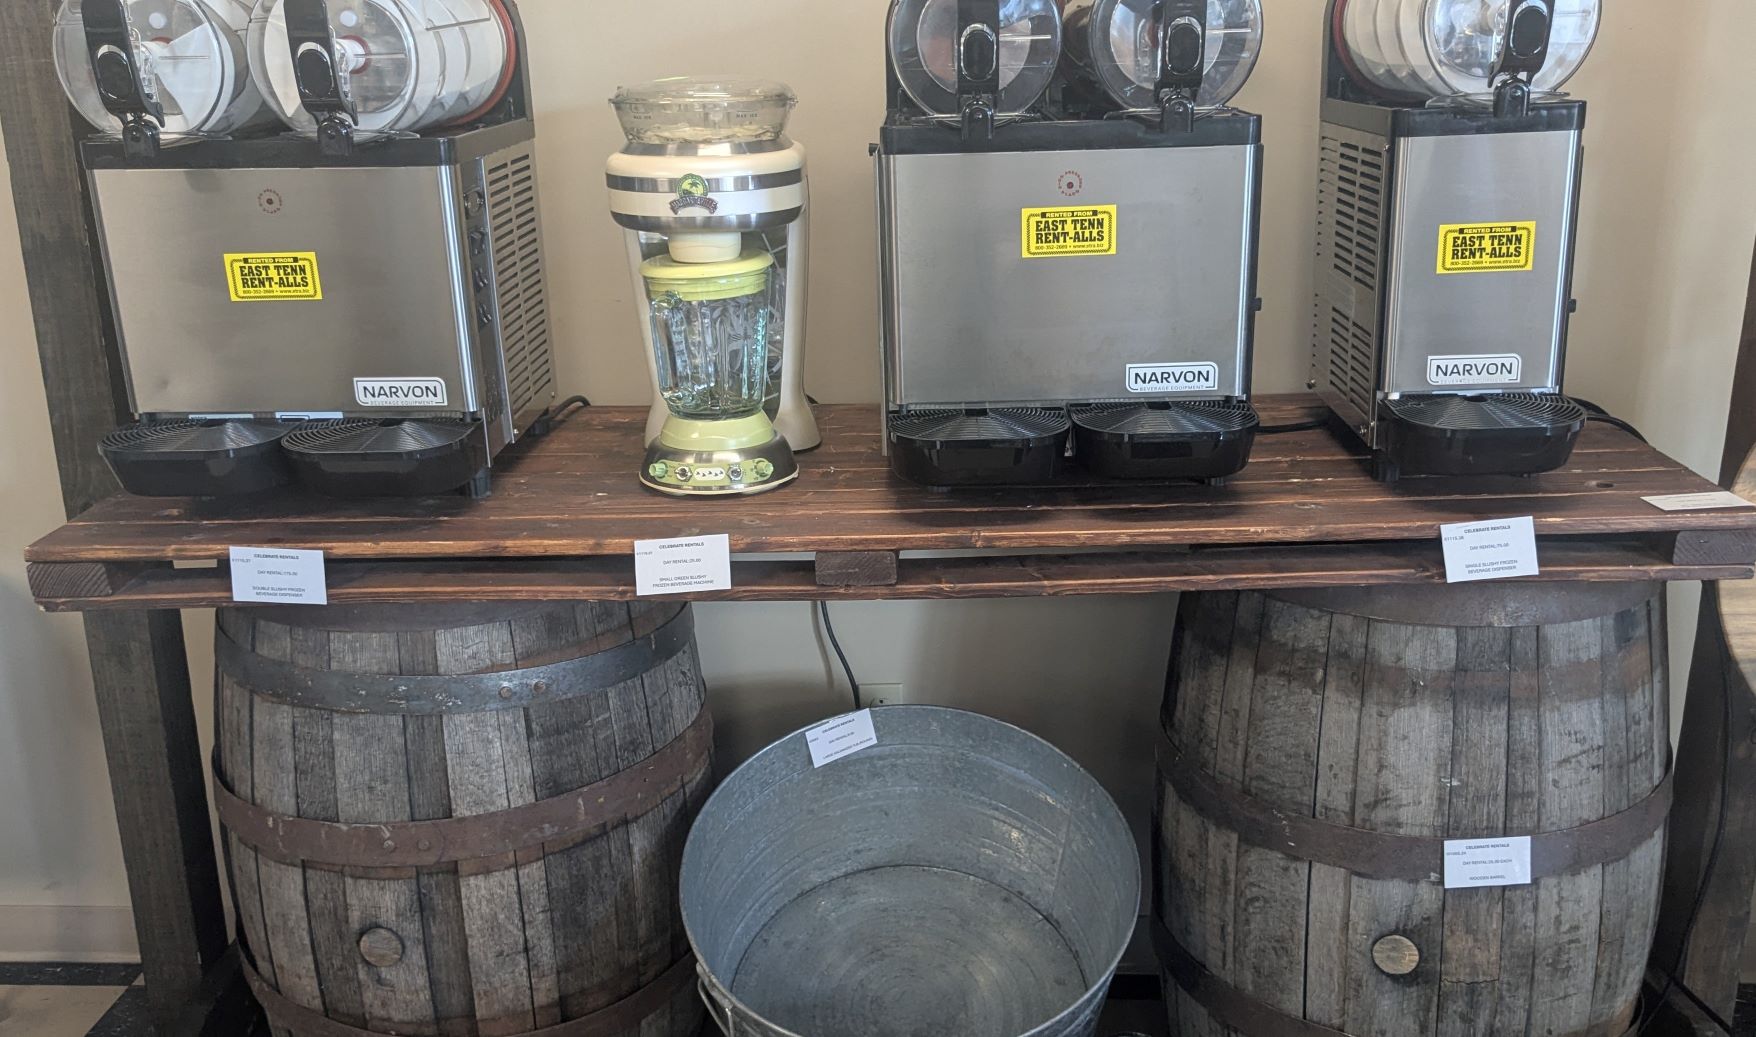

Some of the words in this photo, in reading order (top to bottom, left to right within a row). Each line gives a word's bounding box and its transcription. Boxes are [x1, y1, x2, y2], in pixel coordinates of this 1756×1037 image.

[1036, 220, 1068, 232] EAST
[1071, 218, 1104, 230] TENN
[1036, 230, 1104, 244] RENT-ALLS
[1452, 236, 1485, 248] EAST
[1489, 234, 1522, 246] TENN
[1452, 246, 1522, 260] RENT-ALLS
[239, 266, 270, 276] EAST
[274, 265, 306, 276] TENN
[241, 276, 308, 288] RENT-ALLS
[1436, 362, 1512, 376] NARVON
[1134, 370, 1210, 384] NARVON
[363, 386, 438, 398] NARVON
